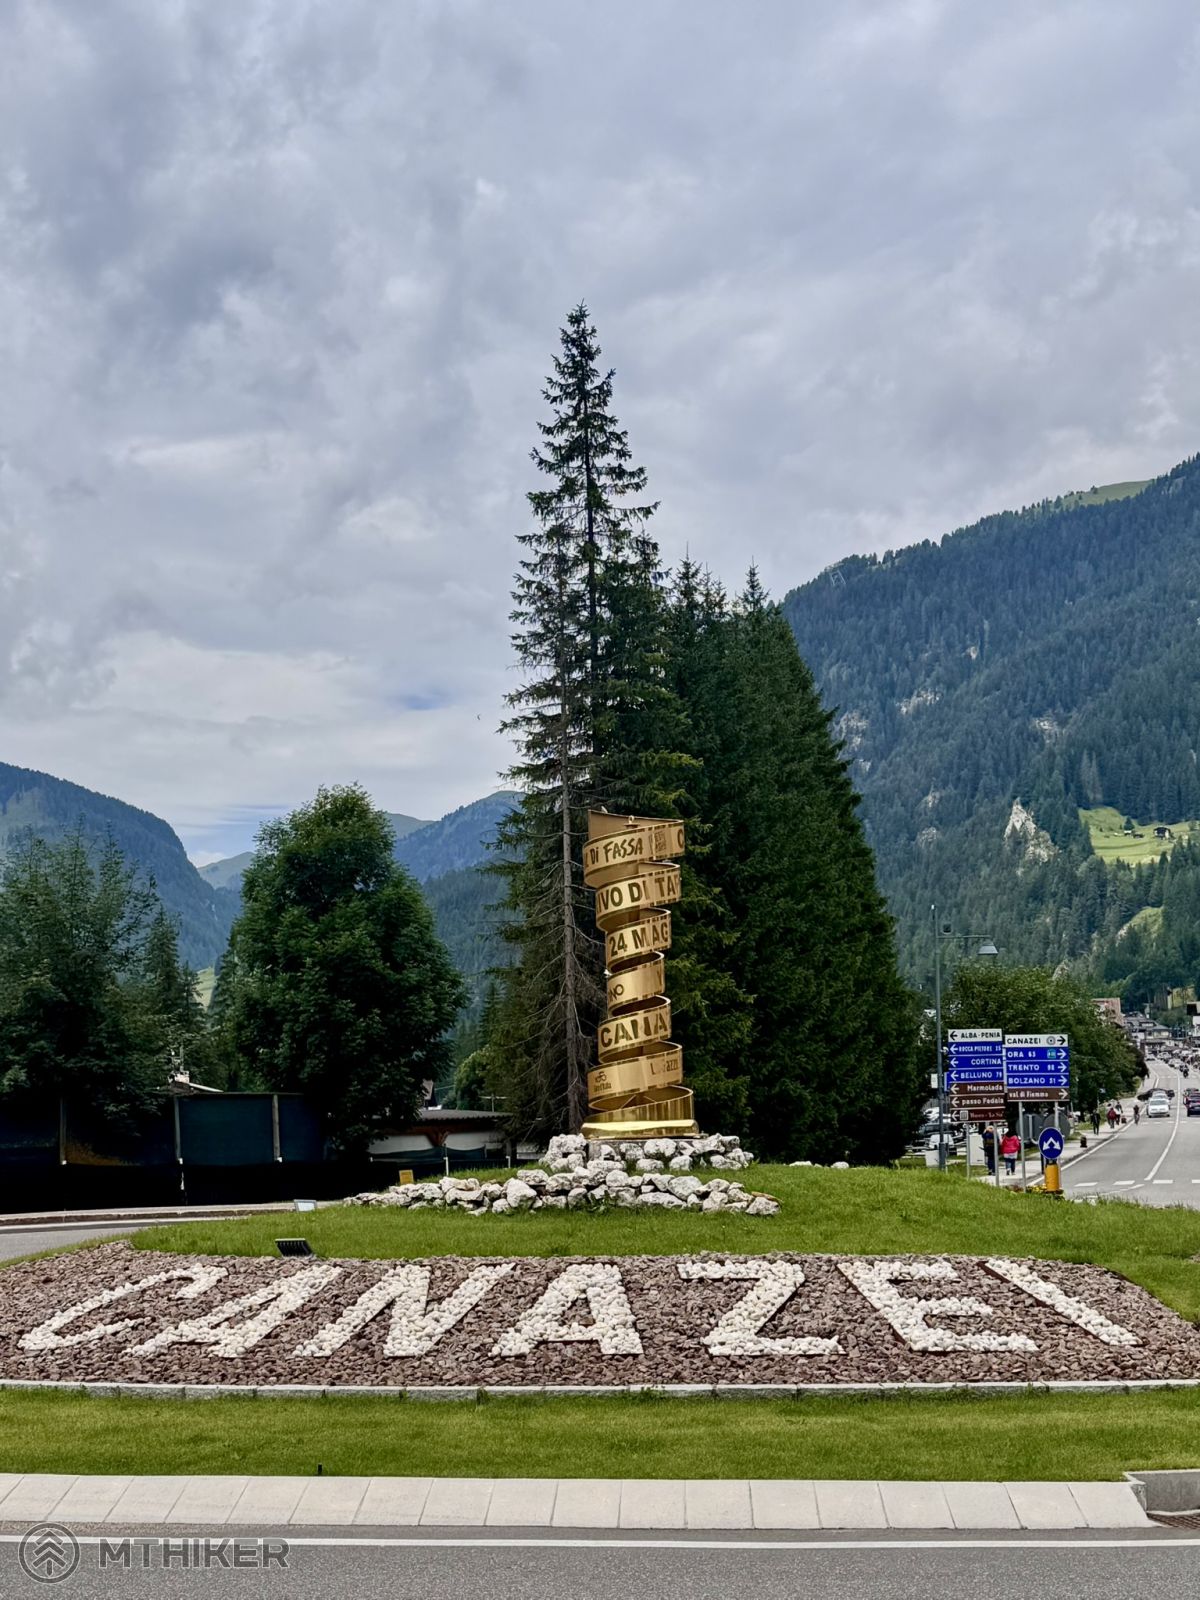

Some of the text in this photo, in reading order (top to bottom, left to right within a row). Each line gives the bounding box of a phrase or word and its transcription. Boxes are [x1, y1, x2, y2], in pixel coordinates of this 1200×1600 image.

[603, 837, 644, 863] FASSA
[627, 880, 650, 903] DI
[609, 932, 627, 957] 24
[1006, 1037, 1041, 1045] CANAZEI
[960, 1071, 992, 1079] BELLUNO
[1008, 1077, 1046, 1085] BOLZANO
[967, 1084, 1003, 1092] Marmolada
[18, 1259, 1142, 1358] CANAZEI
